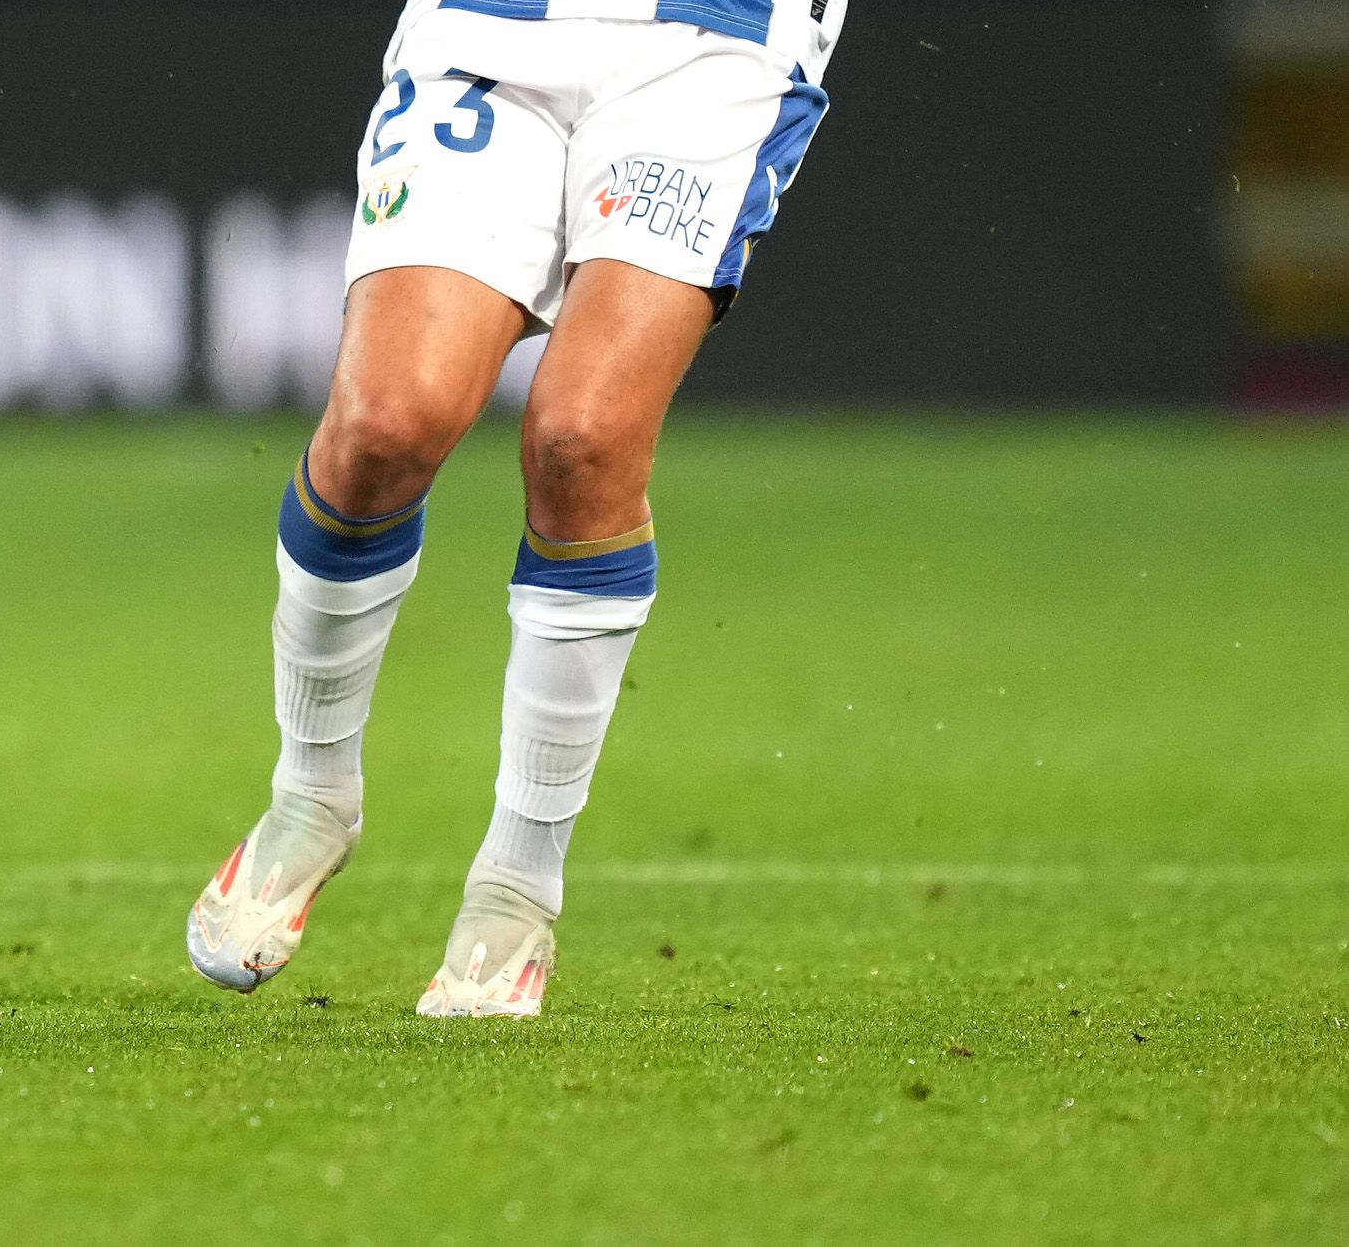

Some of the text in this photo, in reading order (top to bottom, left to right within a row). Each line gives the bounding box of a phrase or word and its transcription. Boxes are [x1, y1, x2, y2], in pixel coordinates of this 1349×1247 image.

[370, 66, 495, 168] 23
[609, 160, 713, 214] URBAN
[624, 195, 715, 256] POKE
